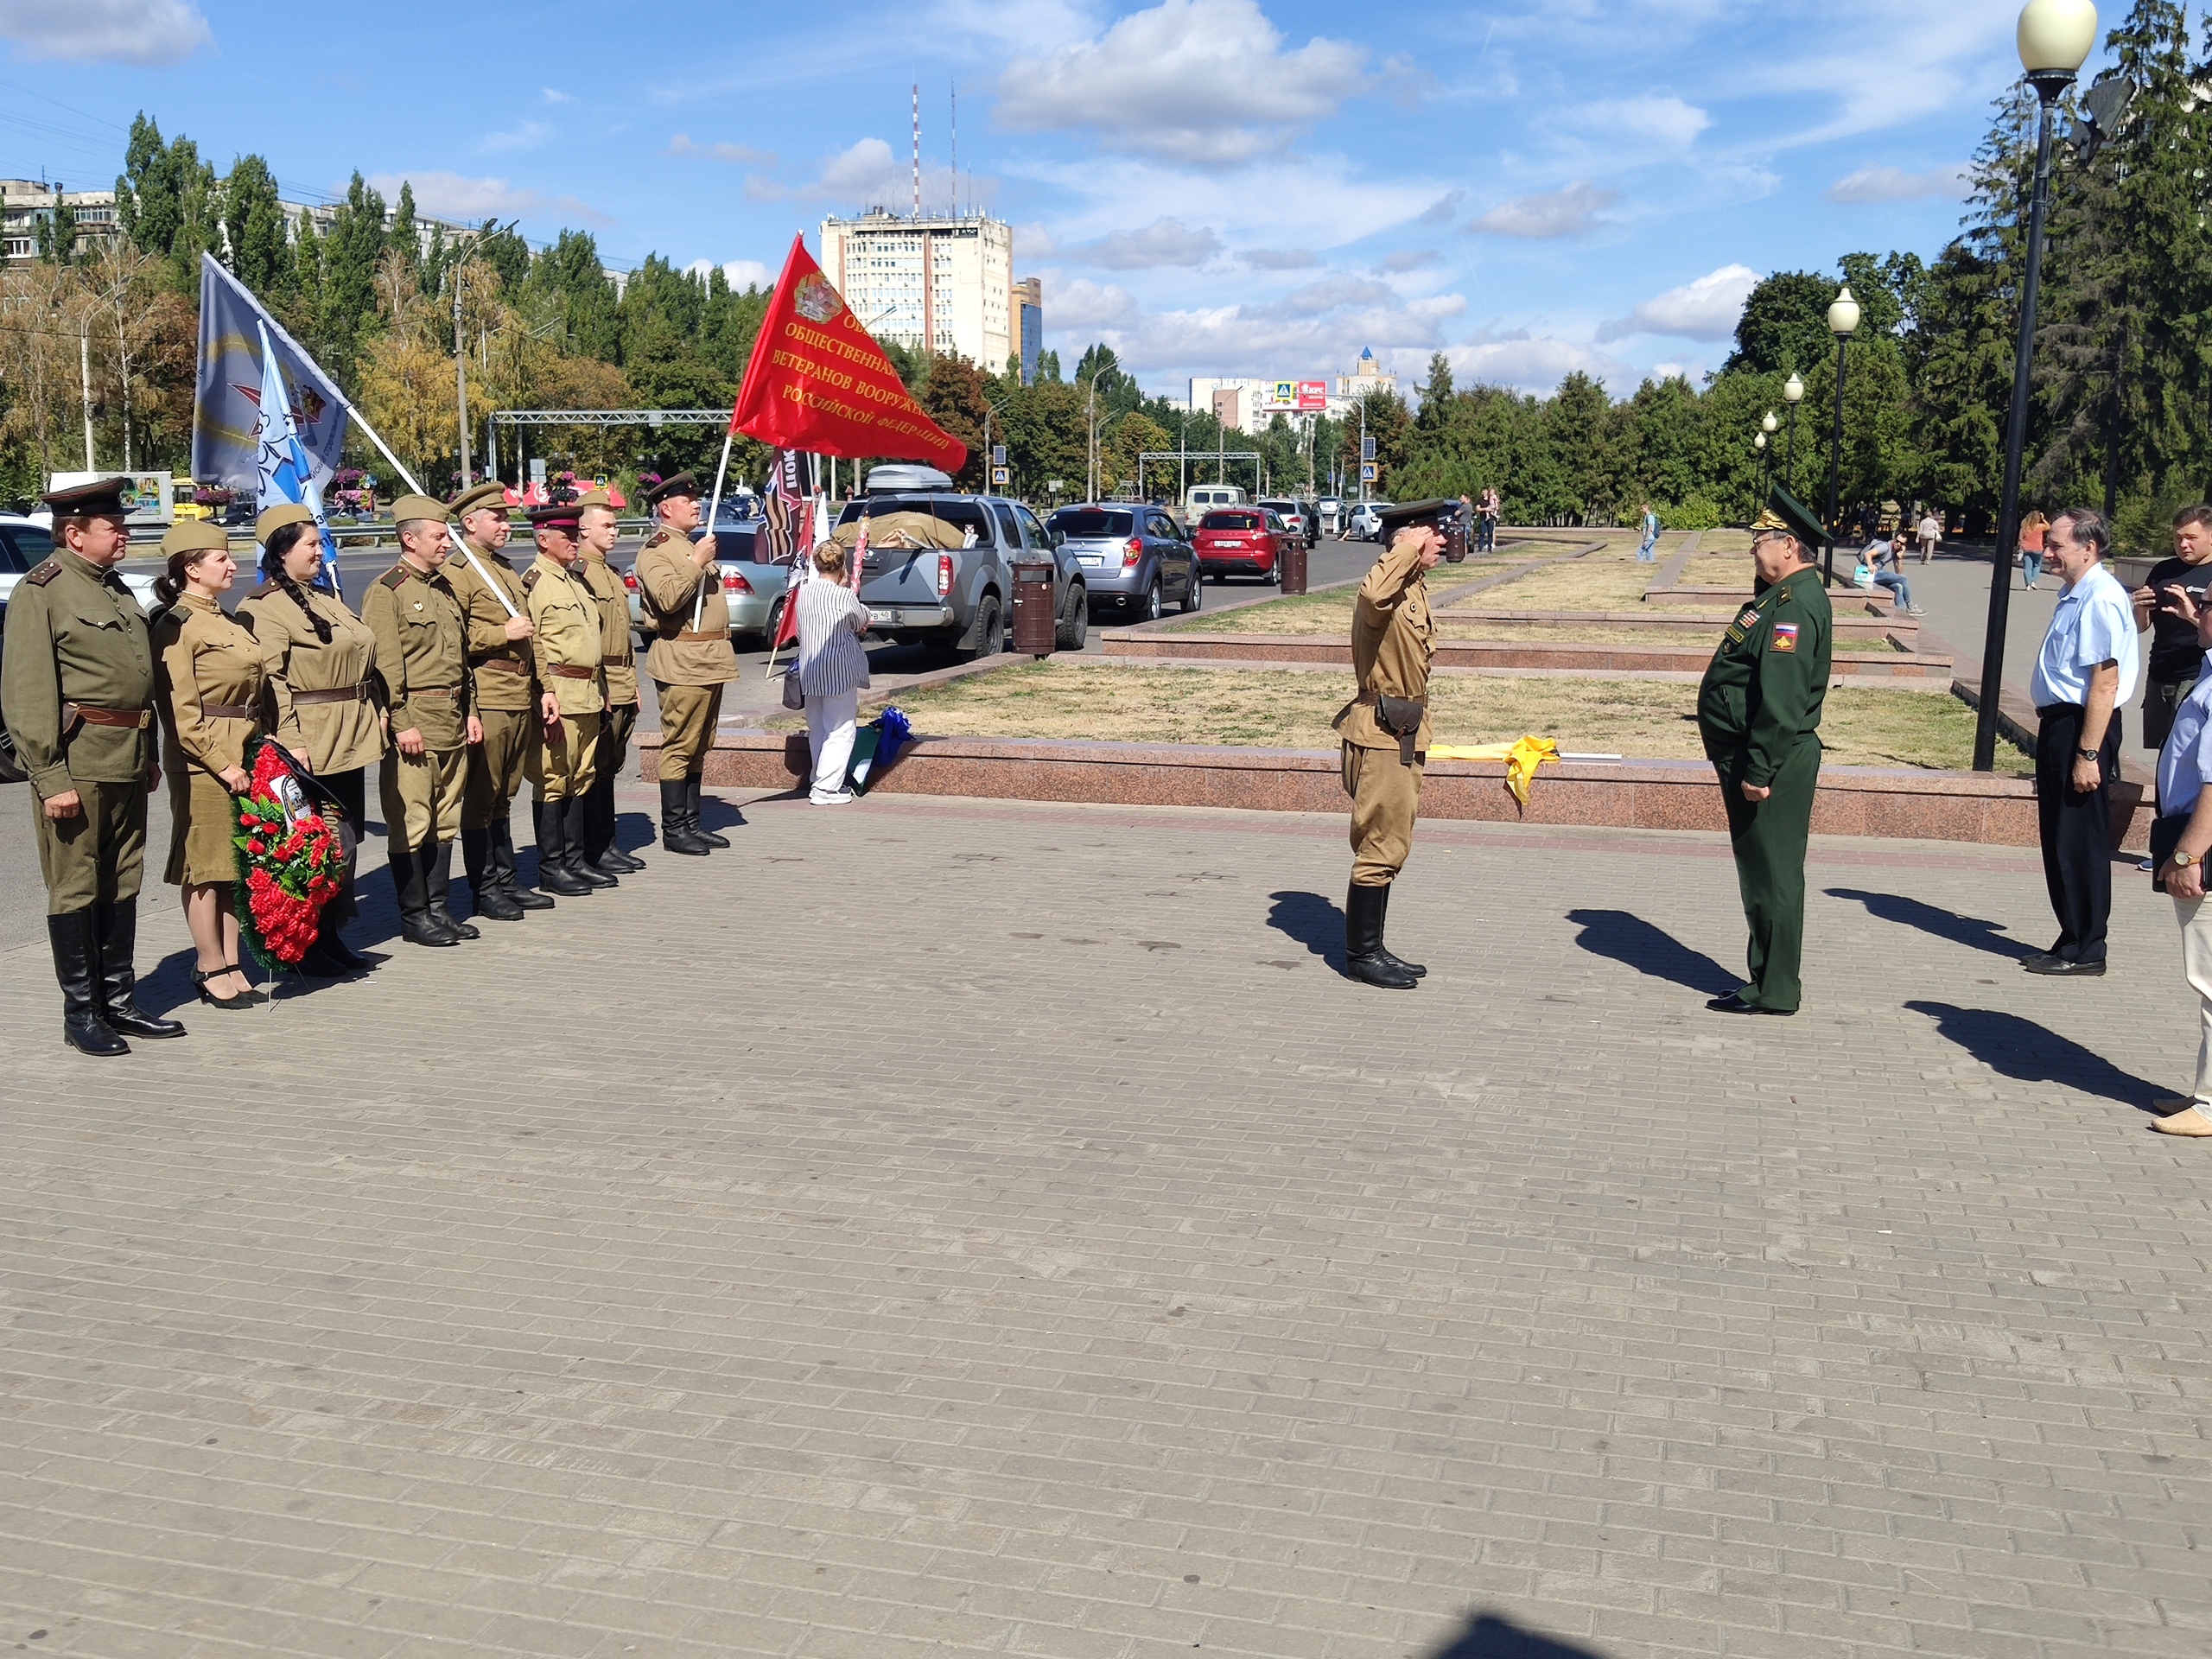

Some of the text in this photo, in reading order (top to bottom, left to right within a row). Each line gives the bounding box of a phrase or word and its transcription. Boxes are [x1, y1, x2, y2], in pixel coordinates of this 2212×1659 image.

[772, 349, 929, 418] ВЕТЕРАНОВ ВООРУЖЕ
[782, 385, 950, 450] РОССИЙСКОЙ ФЕДЕРАЦИИ
